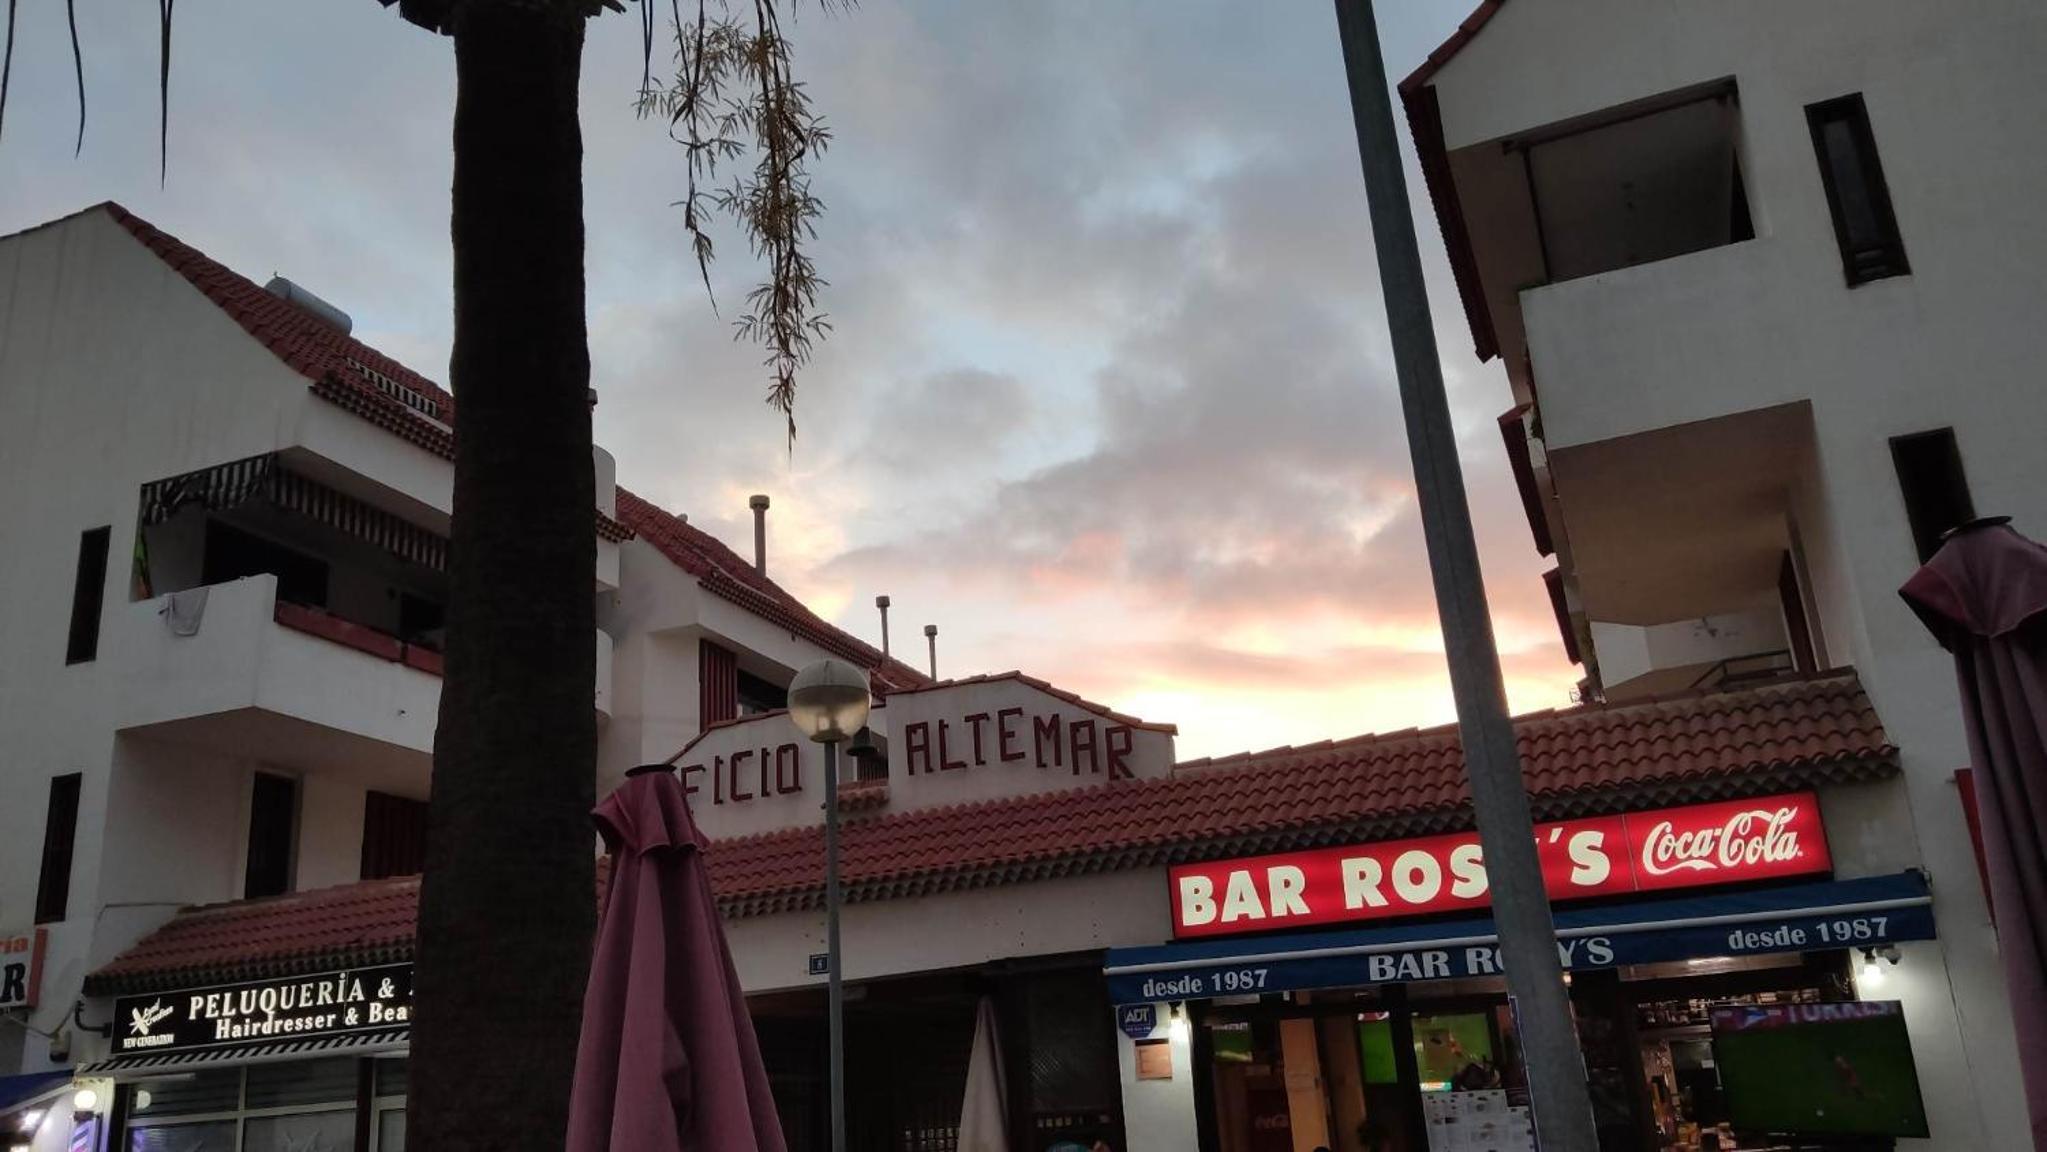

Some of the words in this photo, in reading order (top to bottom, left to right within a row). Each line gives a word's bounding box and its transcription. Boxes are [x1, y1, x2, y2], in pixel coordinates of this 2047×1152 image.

[905, 707, 1134, 780] ALTEMAR
[1642, 806, 1803, 876] Coca-Cola
[1179, 864, 1311, 926] BAR
[1341, 828, 1611, 910] ROS'S
[1728, 926, 1806, 951] desde
[1815, 916, 1888, 943] 1987
[1369, 949, 1450, 981] BAR
[1466, 937, 1615, 976] RY'S
[377, 977, 395, 999] &
[1143, 976, 1202, 998] desde
[1212, 969, 1268, 991] 1987
[215, 1013, 336, 1040] Hairdresser
[345, 1007, 359, 1026] &
[368, 1001, 413, 1024] Bea
[1125, 1007, 1149, 1023] ADT
